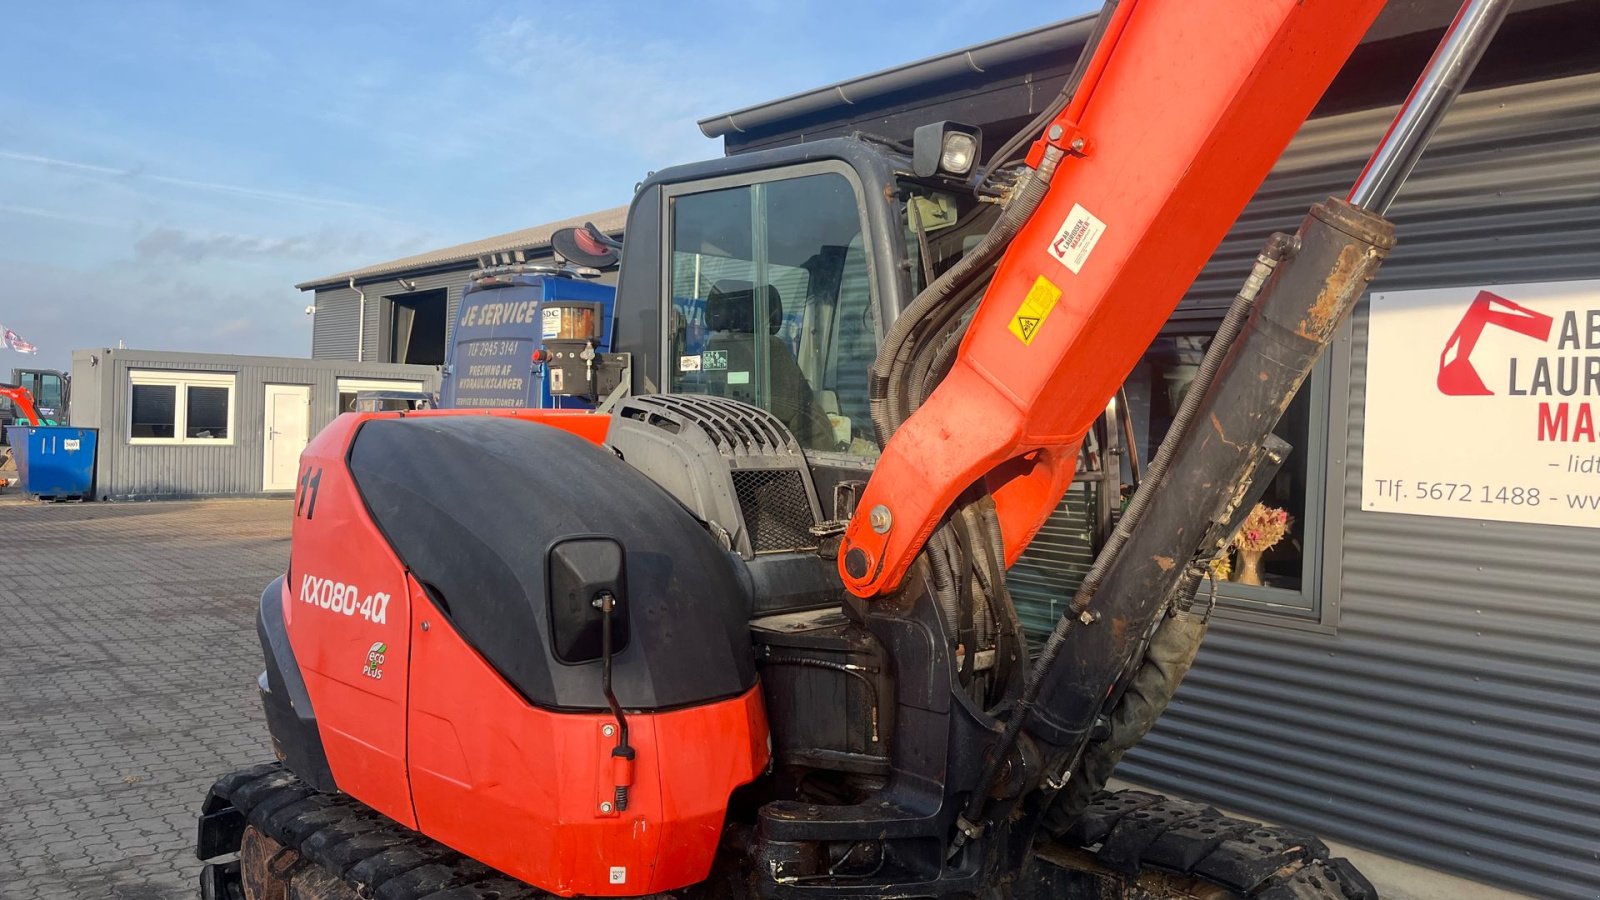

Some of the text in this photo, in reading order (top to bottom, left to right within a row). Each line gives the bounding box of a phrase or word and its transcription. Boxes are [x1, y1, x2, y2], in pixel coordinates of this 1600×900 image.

[461, 305, 479, 327] JE
[478, 301, 538, 326] SERVICE
[1557, 310, 1600, 350] AB
[479, 341, 499, 357] 2945
[499, 340, 519, 356] 3141
[1508, 356, 1600, 396] LAUR
[1537, 402, 1600, 443] MA
[297, 466, 322, 520] 11
[1375, 480, 1408, 502] Tlf.
[1416, 482, 1472, 503] 5672
[1481, 485, 1540, 507] 1488
[363, 665, 383, 679] PLUS
[369, 652, 385, 665] eco
